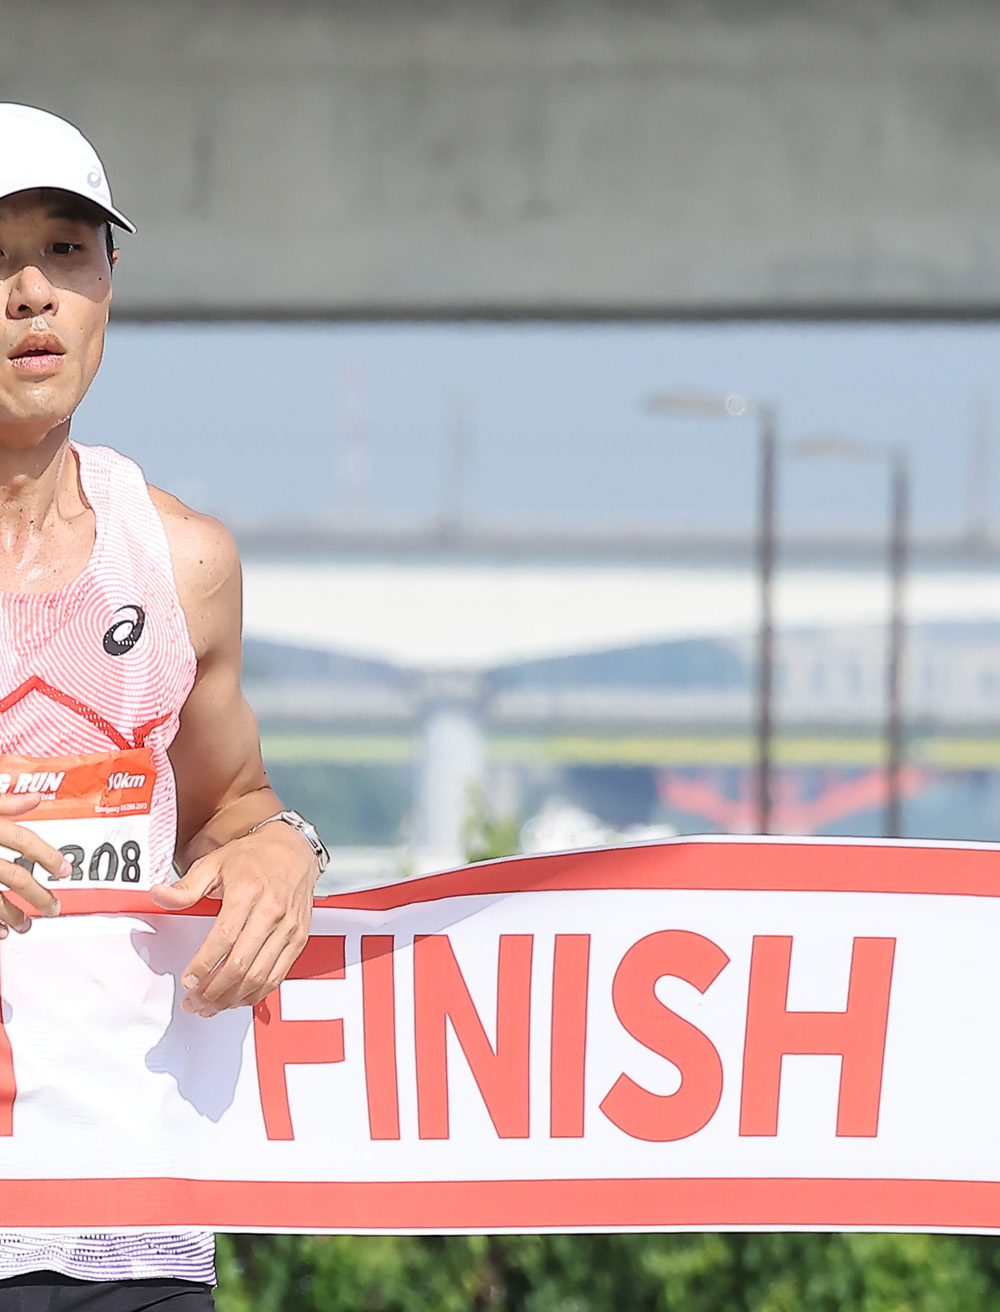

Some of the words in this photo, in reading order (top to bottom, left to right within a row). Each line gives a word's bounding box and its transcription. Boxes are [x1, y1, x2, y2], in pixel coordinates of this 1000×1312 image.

[13, 772, 66, 794] RUN
[108, 771, 146, 790] 10km
[253, 929, 897, 1142] FINISH
